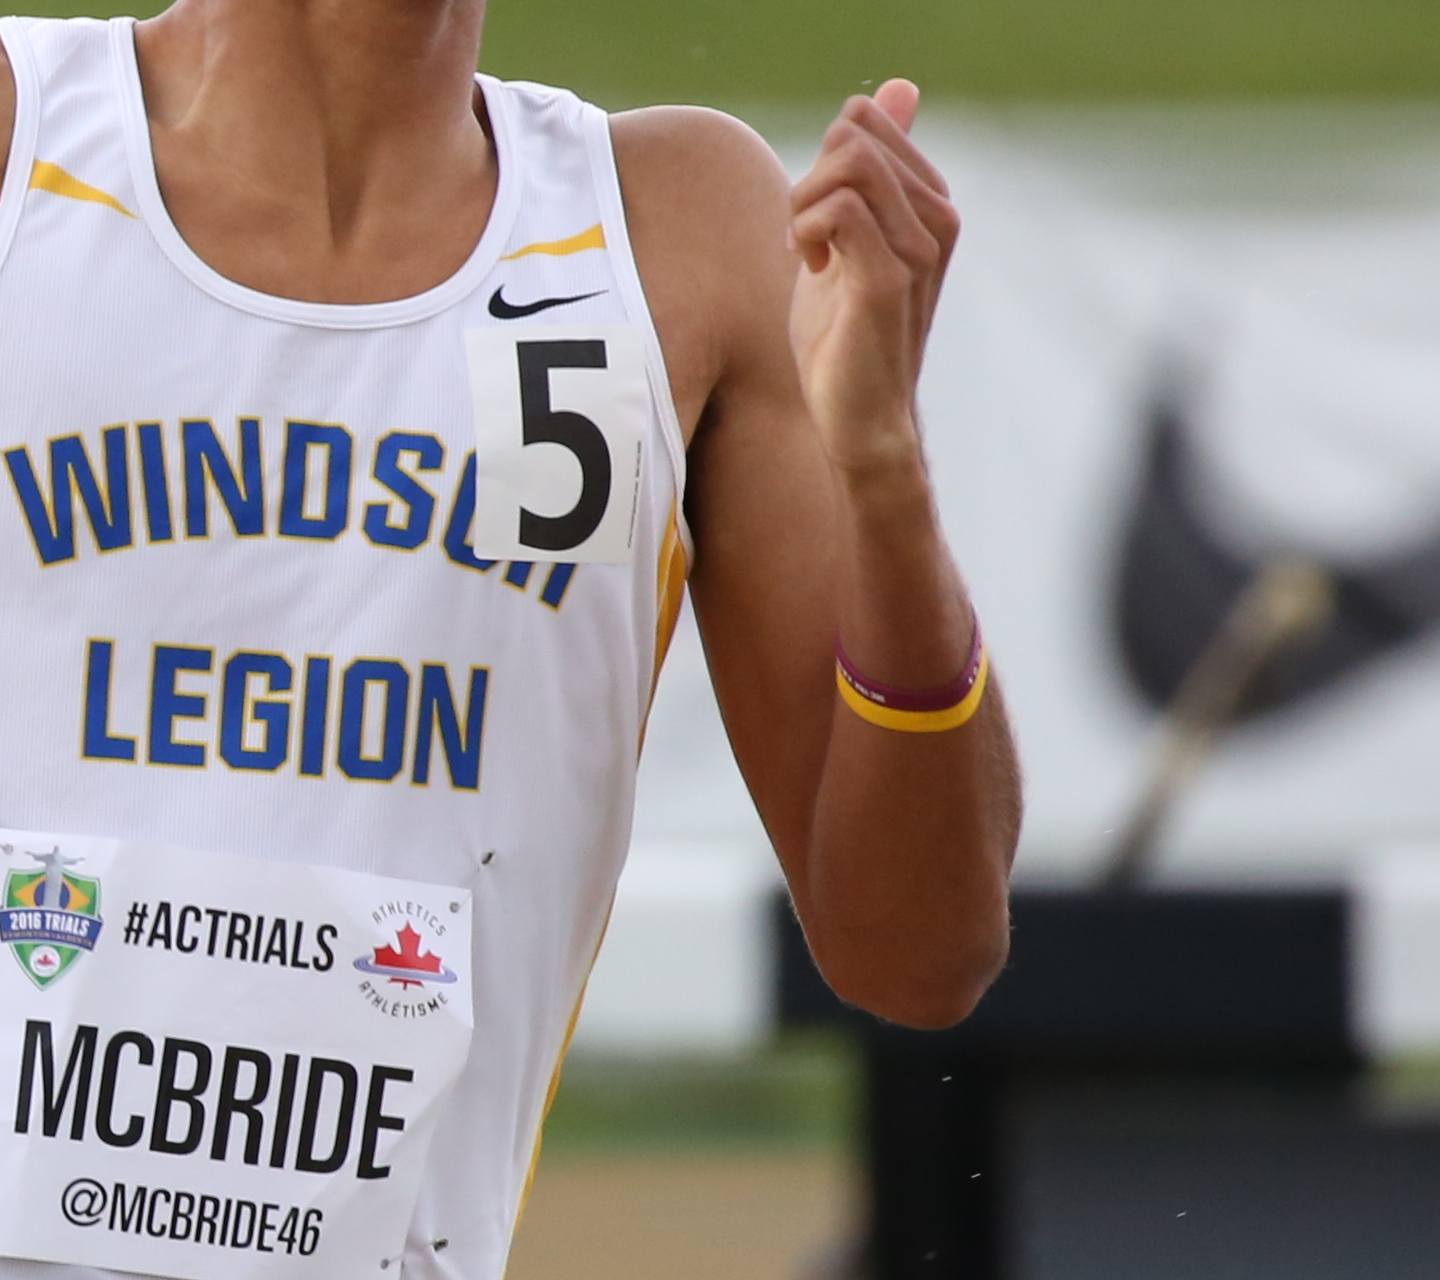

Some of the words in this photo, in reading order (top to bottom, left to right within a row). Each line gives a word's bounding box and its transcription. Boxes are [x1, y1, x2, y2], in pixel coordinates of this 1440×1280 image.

[516, 339, 612, 551] 5
[79, 636, 492, 793] LEGION
[8, 912, 42, 931] 2016
[45, 913, 91, 938] TRIALS
[123, 901, 339, 972] #ACTRIALS
[372, 901, 447, 937] ATHLETICS
[14, 1018, 415, 1180] MCBRIDE
[61, 1177, 324, 1257] @MCBRIDE46
